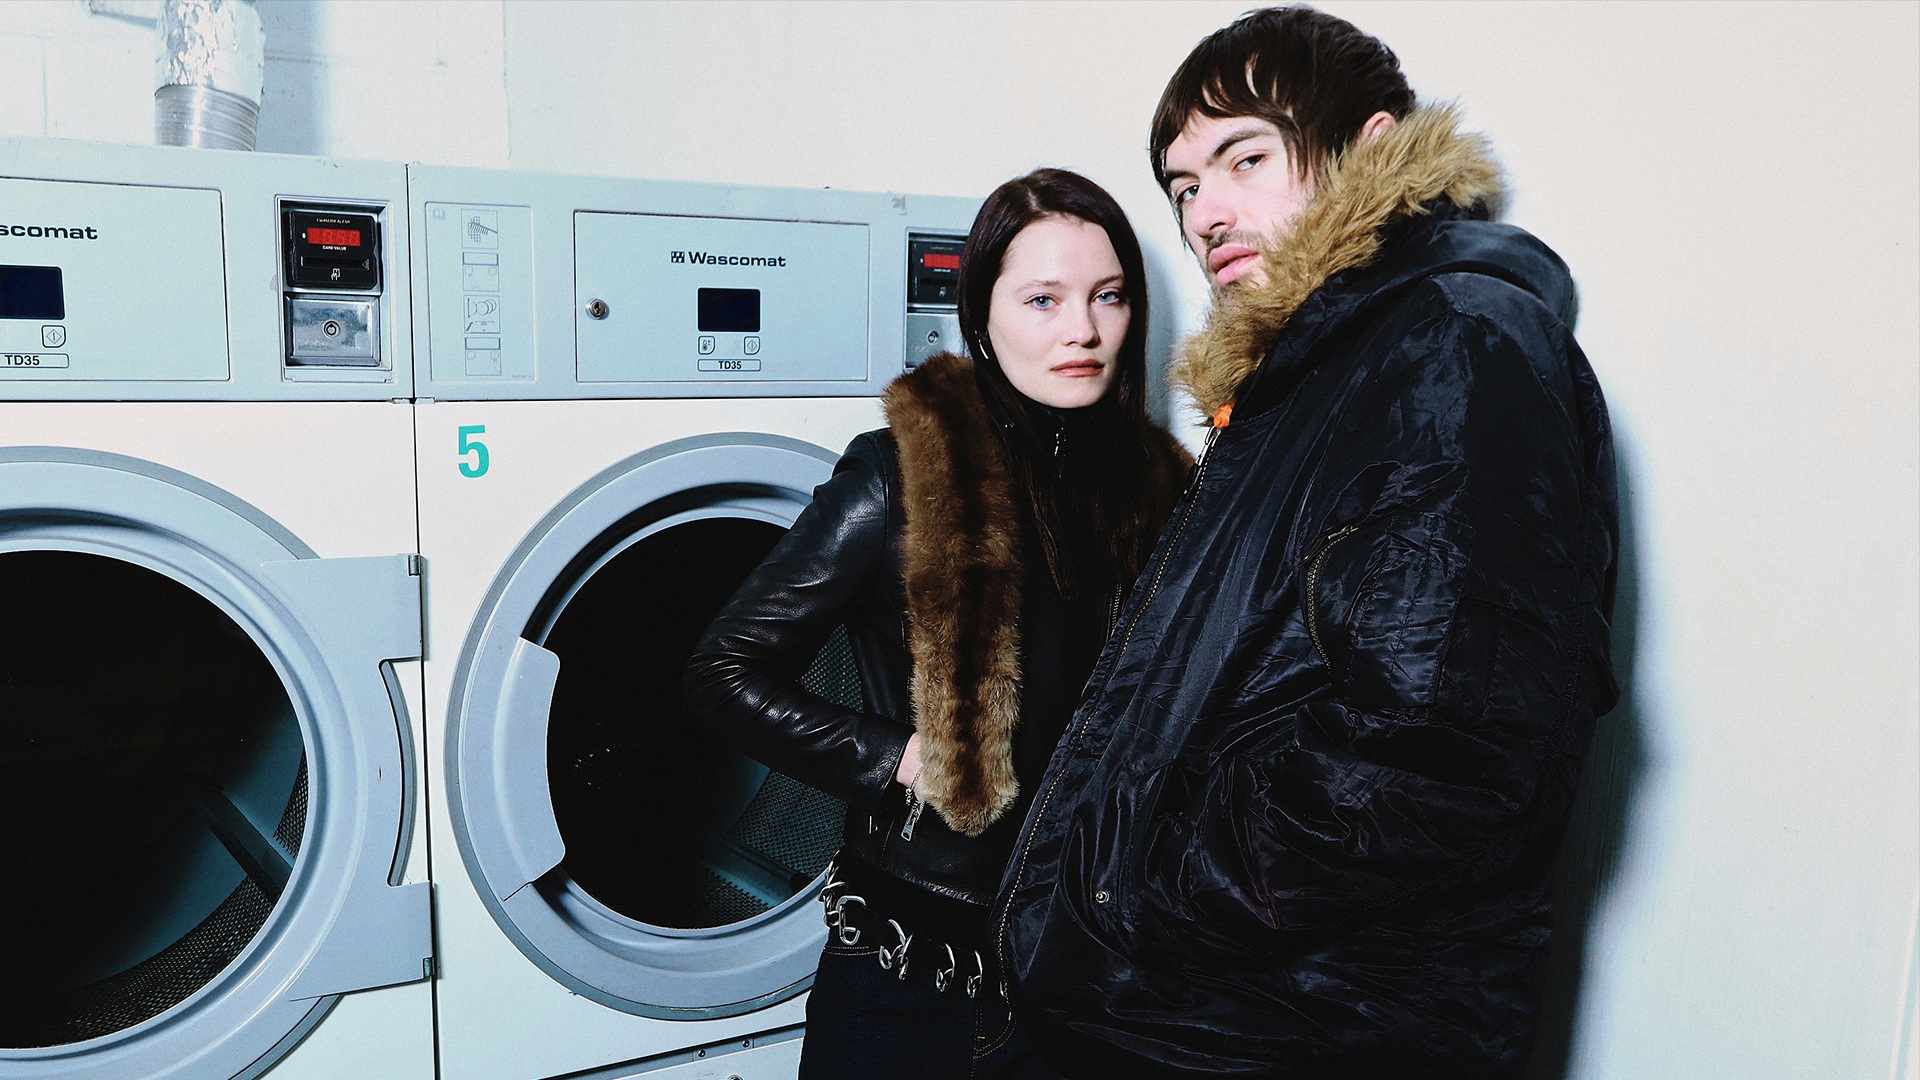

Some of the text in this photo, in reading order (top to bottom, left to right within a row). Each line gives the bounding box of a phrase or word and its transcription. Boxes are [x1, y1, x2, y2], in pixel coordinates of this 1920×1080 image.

[688, 251, 786, 267] Wascomat
[4, 355, 40, 366] TD35
[718, 360, 742, 370] TD35
[458, 424, 490, 478] 5
